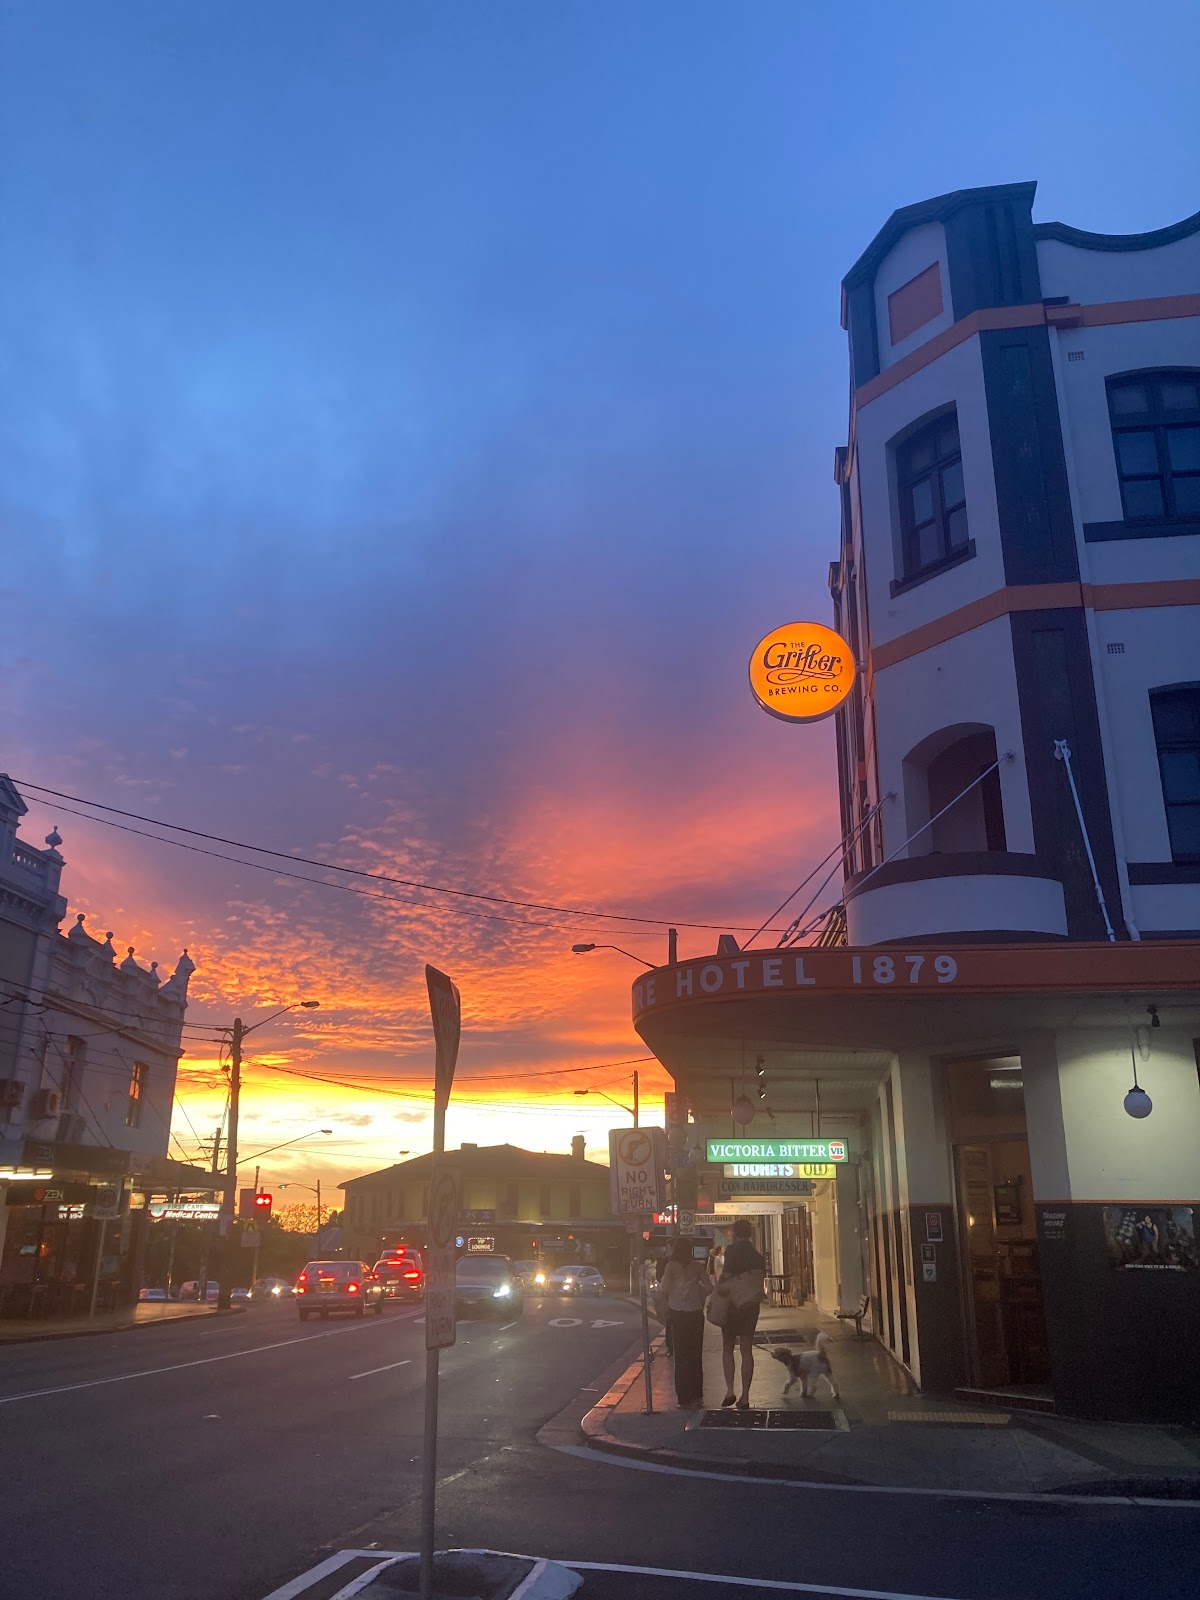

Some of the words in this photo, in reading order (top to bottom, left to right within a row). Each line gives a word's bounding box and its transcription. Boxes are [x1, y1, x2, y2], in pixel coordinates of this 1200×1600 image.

[790, 641, 806, 649] THE
[763, 641, 843, 675] Grifter
[768, 685, 818, 697] BREWING
[824, 684, 842, 693] CO.
[676, 956, 816, 998] HOTEL
[852, 955, 958, 984] 1879
[710, 1144, 776, 1157] VICTORIA
[779, 1144, 827, 1157] BITTER
[830, 1146, 843, 1155] VB
[626, 1170, 648, 1184] NO
[621, 1185, 655, 1197] RIGHT
[743, 1181, 809, 1192] HAIRDRESSER
[44, 1189, 64, 1200] ZEN
[623, 1198, 653, 1212] TURN
[165, 1211, 194, 1219] Medical
[194, 1211, 219, 1220] Centre
[682, 1215, 691, 1223] 40
[695, 1214, 732, 1222] Delicious
